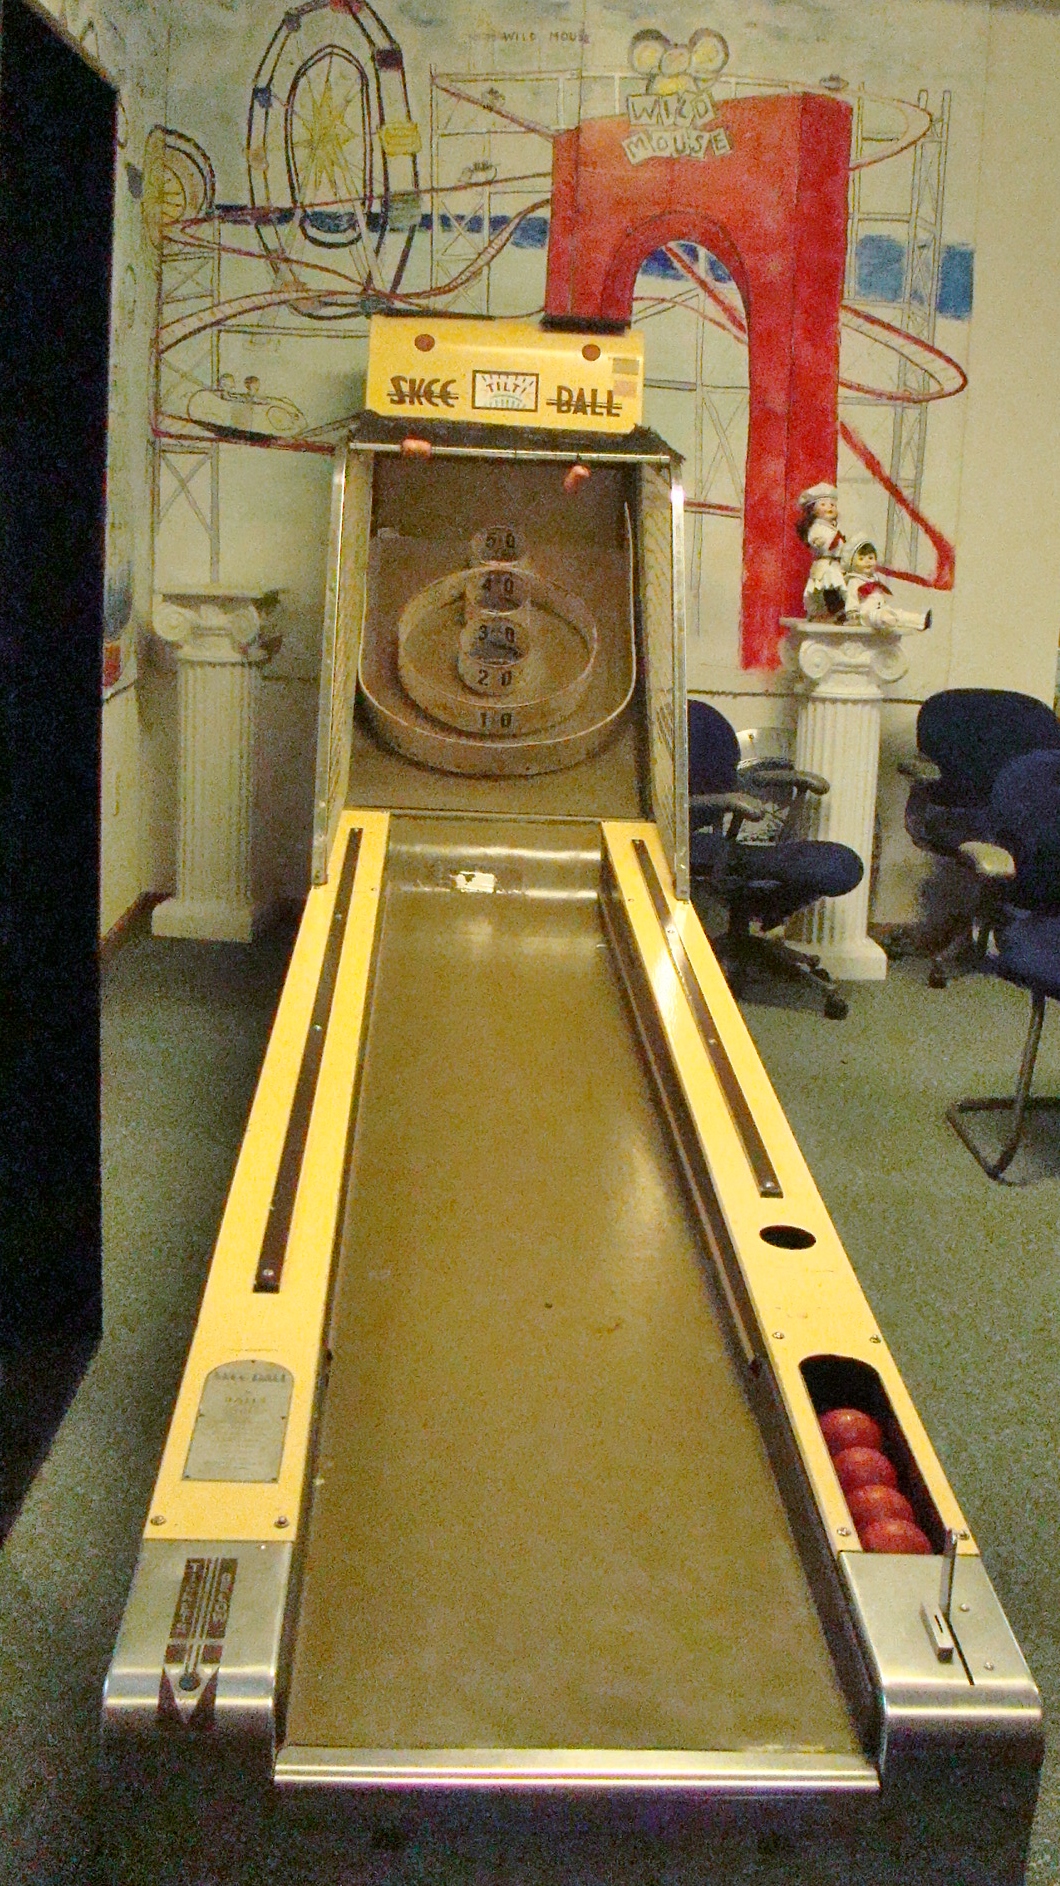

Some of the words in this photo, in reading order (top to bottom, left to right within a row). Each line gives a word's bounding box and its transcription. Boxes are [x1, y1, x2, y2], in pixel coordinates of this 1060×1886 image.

[502, 31, 535, 42] WILD
[631, 97, 709, 121] WILD
[627, 133, 727, 160] MOUSE
[388, 375, 459, 408] SKEE
[549, 384, 622, 418] BALL
[485, 531, 516, 549] 50
[481, 577, 515, 595] 40
[478, 624, 515, 643] 30
[478, 669, 513, 687] 20
[480, 712, 513, 728] 10
